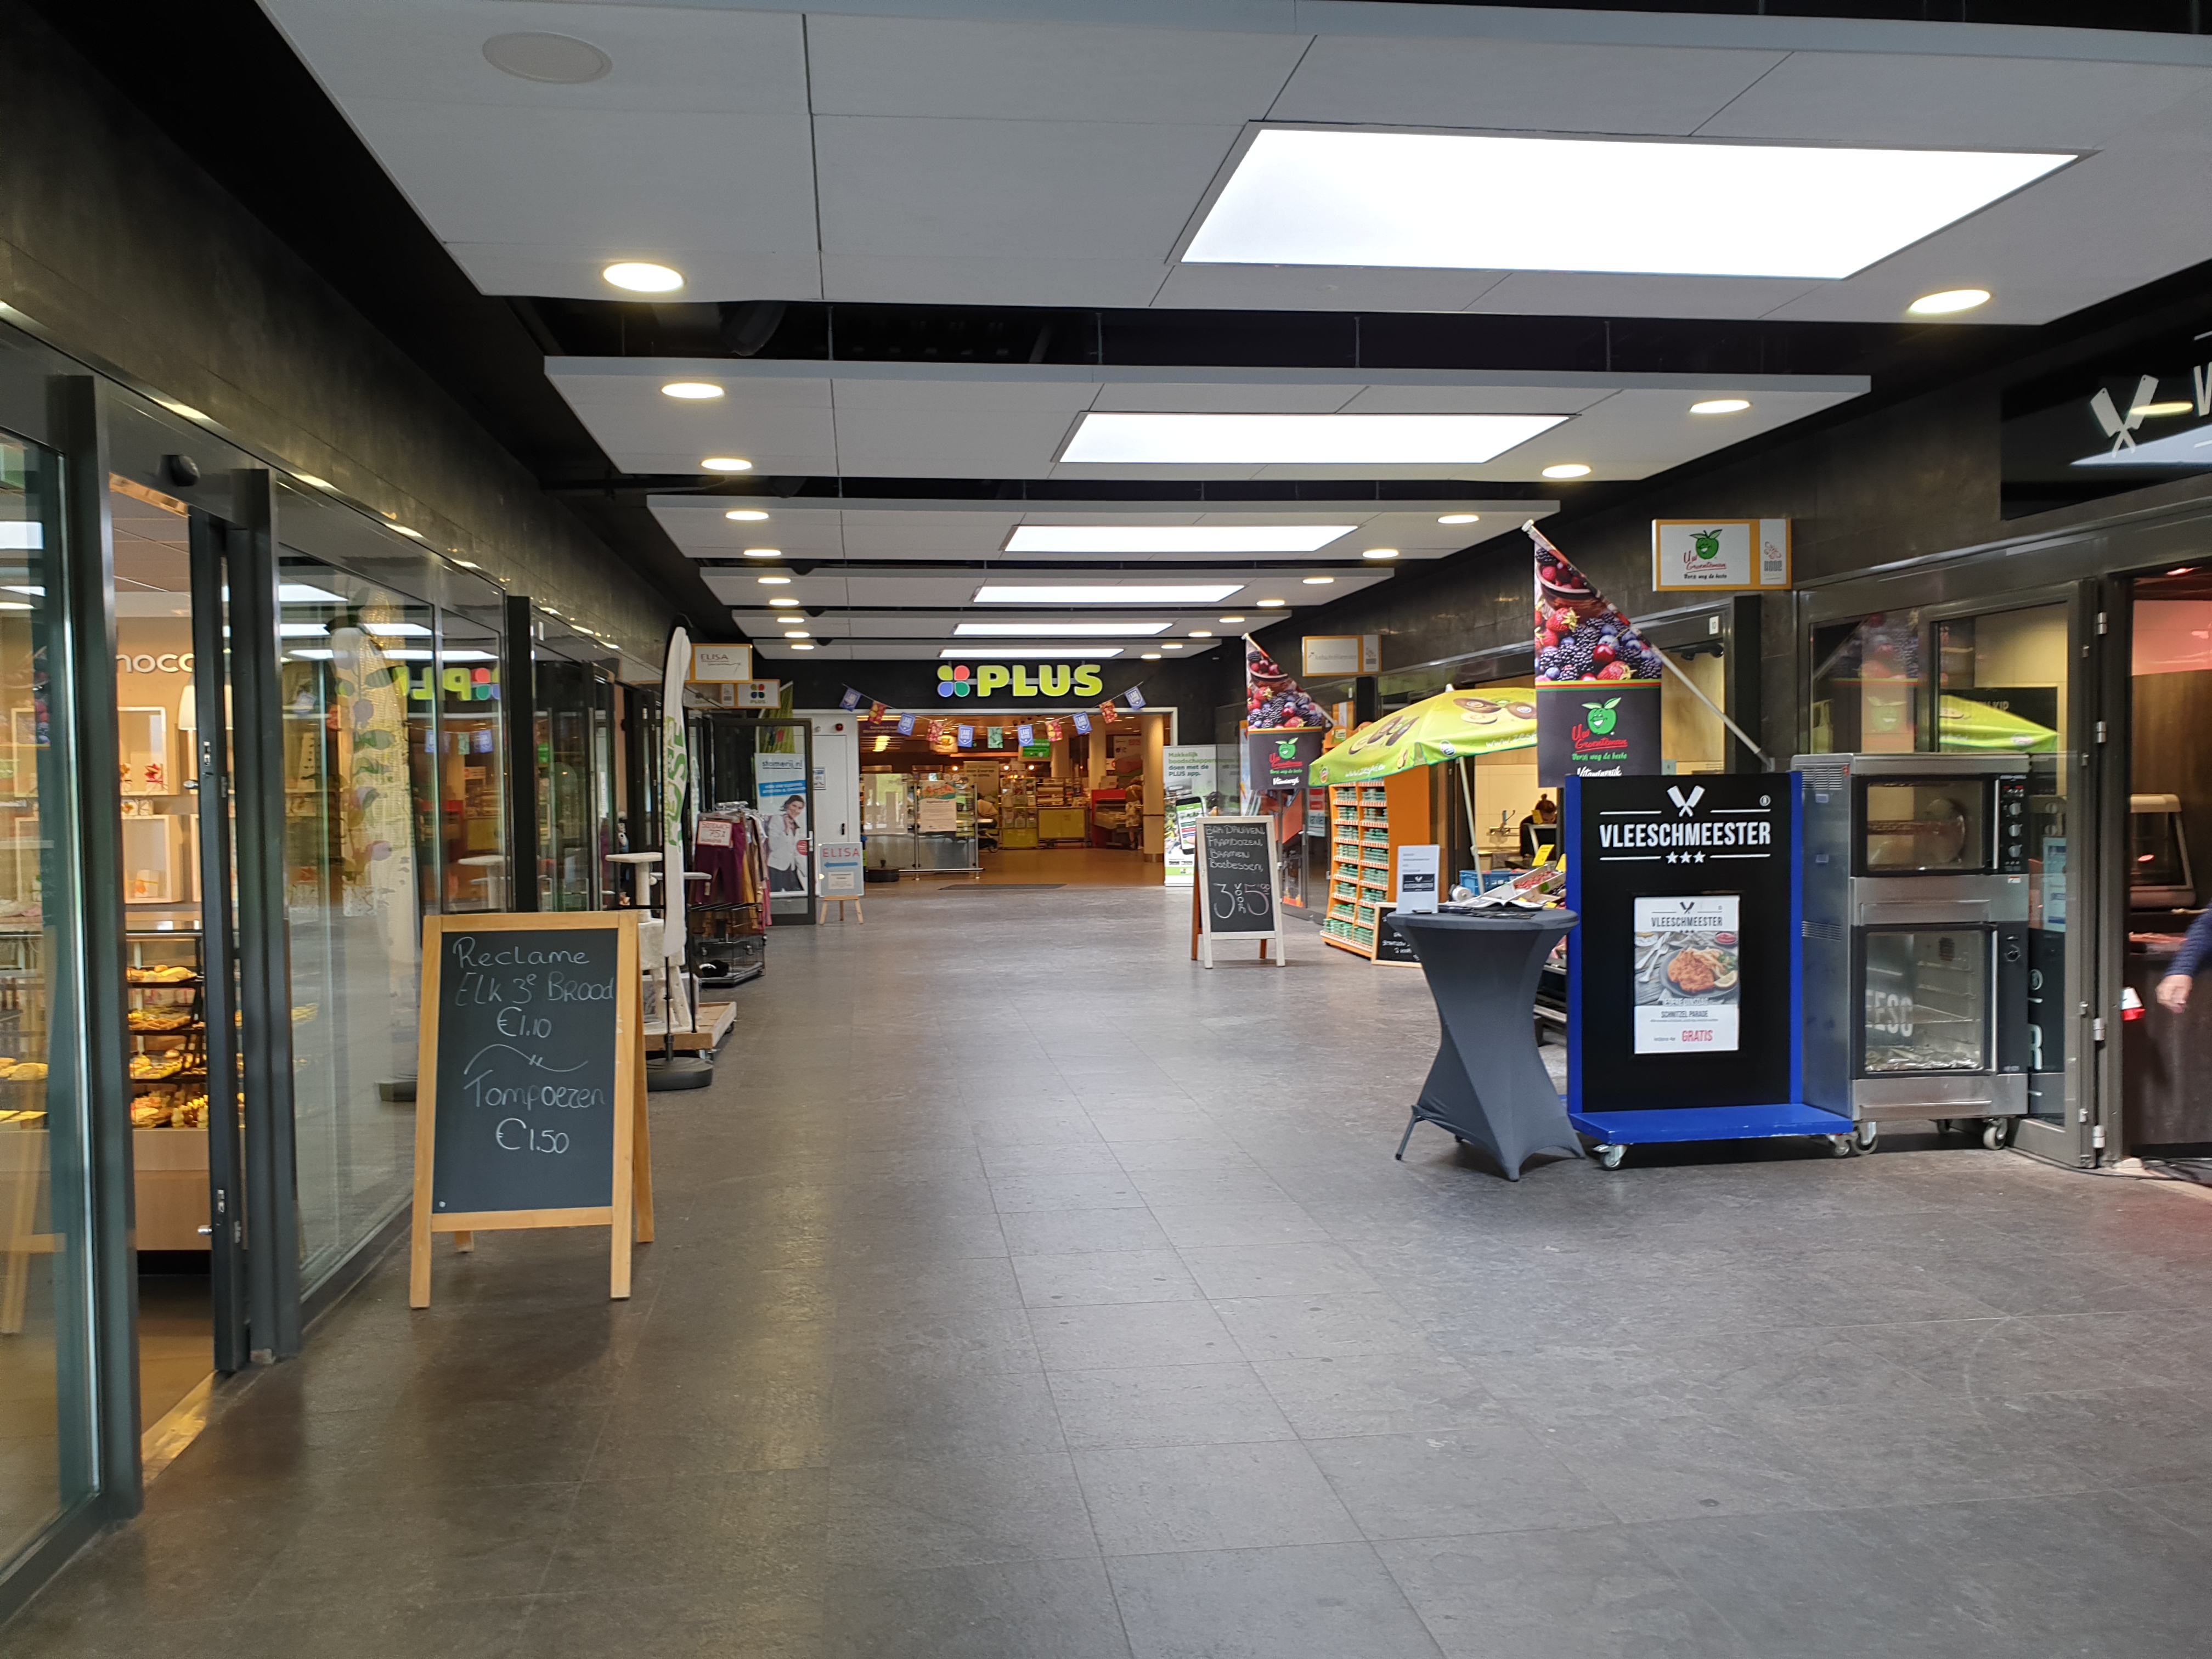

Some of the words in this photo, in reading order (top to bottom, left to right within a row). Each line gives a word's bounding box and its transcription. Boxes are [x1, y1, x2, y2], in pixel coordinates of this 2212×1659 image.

[977, 664, 1103, 697] PLUS
[1571, 724, 1590, 741] Uw
[1599, 821, 1771, 848] VLEESCHMEESTER
[822, 848, 860, 857] ELISA
[1213, 883, 1235, 919] 3
[1651, 917, 1723, 927] VLEESCHMEESTER
[453, 936, 590, 967] Reclame
[1681, 1030, 1713, 1042] GRATIS
